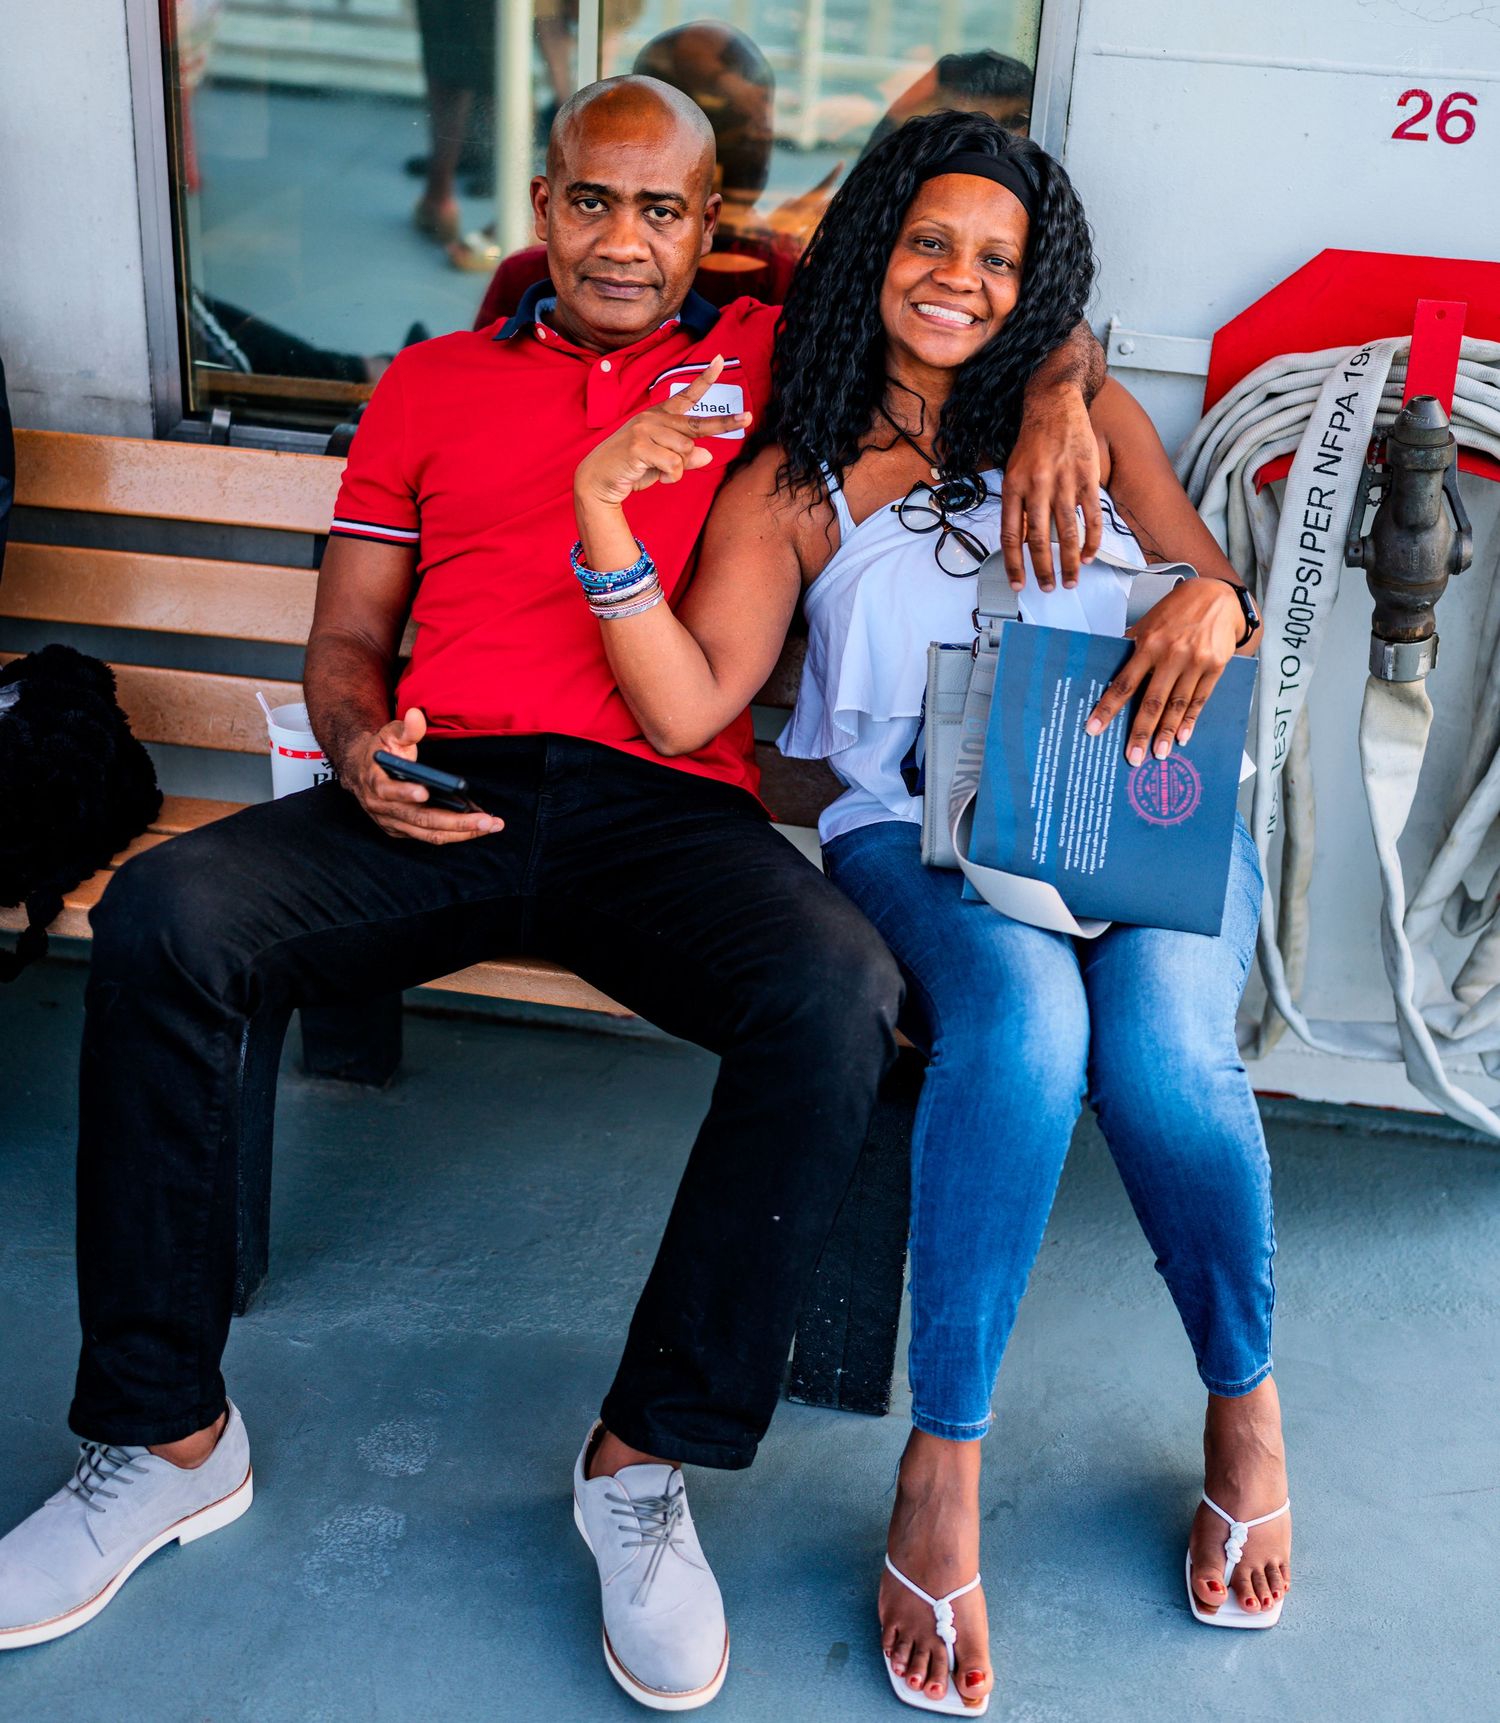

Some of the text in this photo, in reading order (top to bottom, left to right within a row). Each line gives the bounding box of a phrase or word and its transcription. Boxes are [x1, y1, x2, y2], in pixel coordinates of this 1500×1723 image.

[1391, 88, 1478, 144] 26
[1313, 392, 1359, 476] NFPA
[1300, 486, 1336, 553] PER
[1278, 655, 1300, 697] TO
